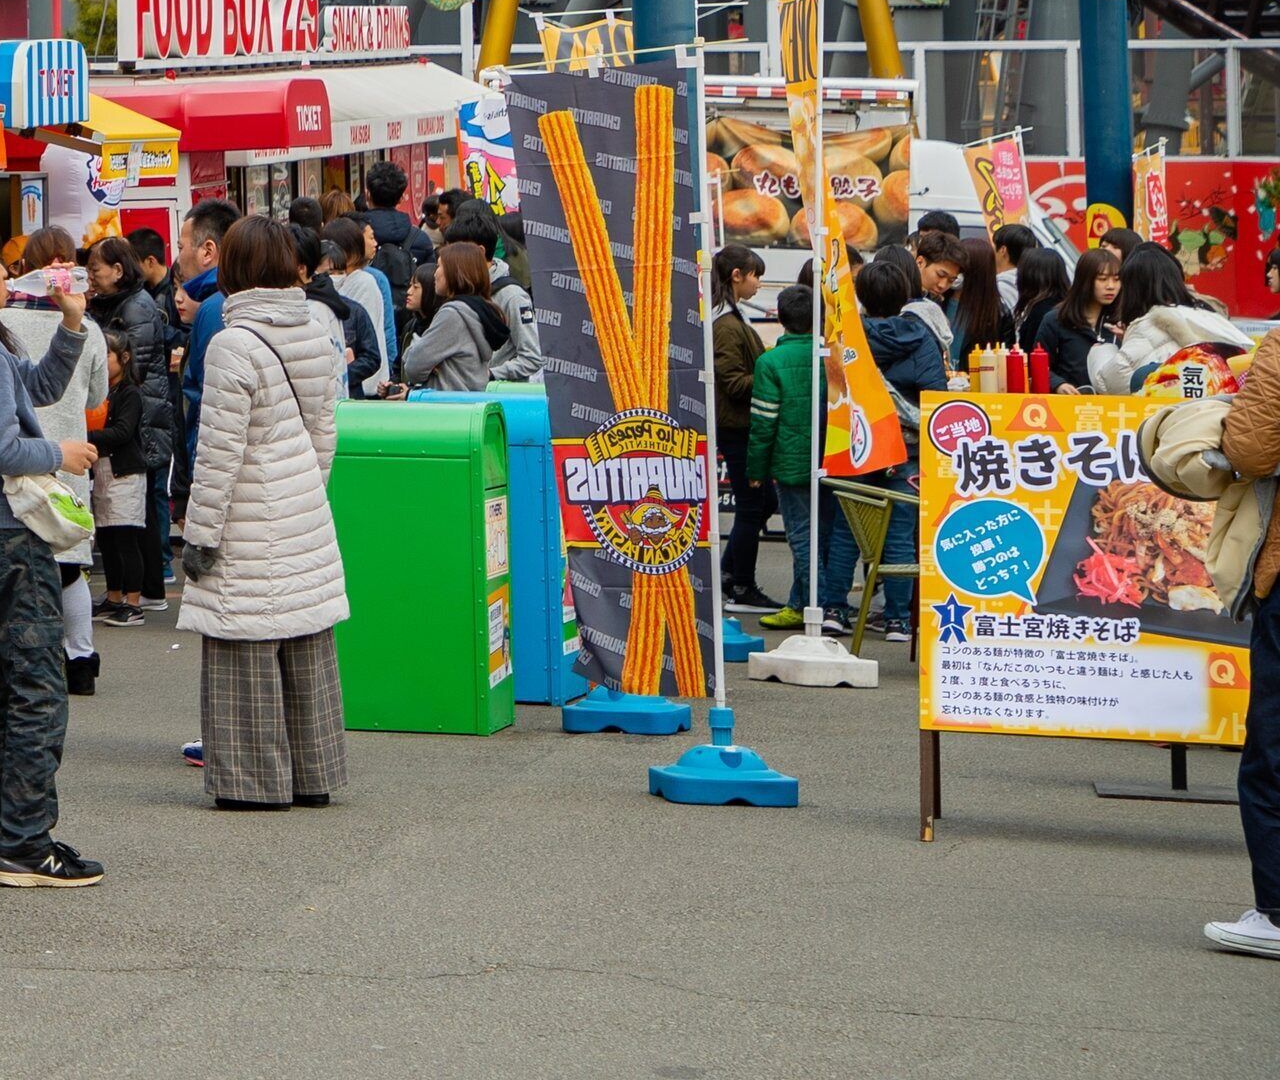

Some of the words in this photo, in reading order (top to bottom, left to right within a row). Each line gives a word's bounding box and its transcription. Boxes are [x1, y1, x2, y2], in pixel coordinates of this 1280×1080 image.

[330, 6, 366, 52] SNACK
[366, 12, 374, 50] &
[376, 5, 411, 49] DRINKS
[39, 68, 76, 98] TICKET
[295, 104, 322, 132] TICKET
[349, 123, 371, 146] YAKISOBA
[935, 416, 983, 442] ご当地
[939, 508, 1021, 552] 気に入った方に
[971, 545, 1021, 575] 勝つのは
[946, 602, 956, 619] 1
[973, 614, 1138, 643] 富士宮焼きそば
